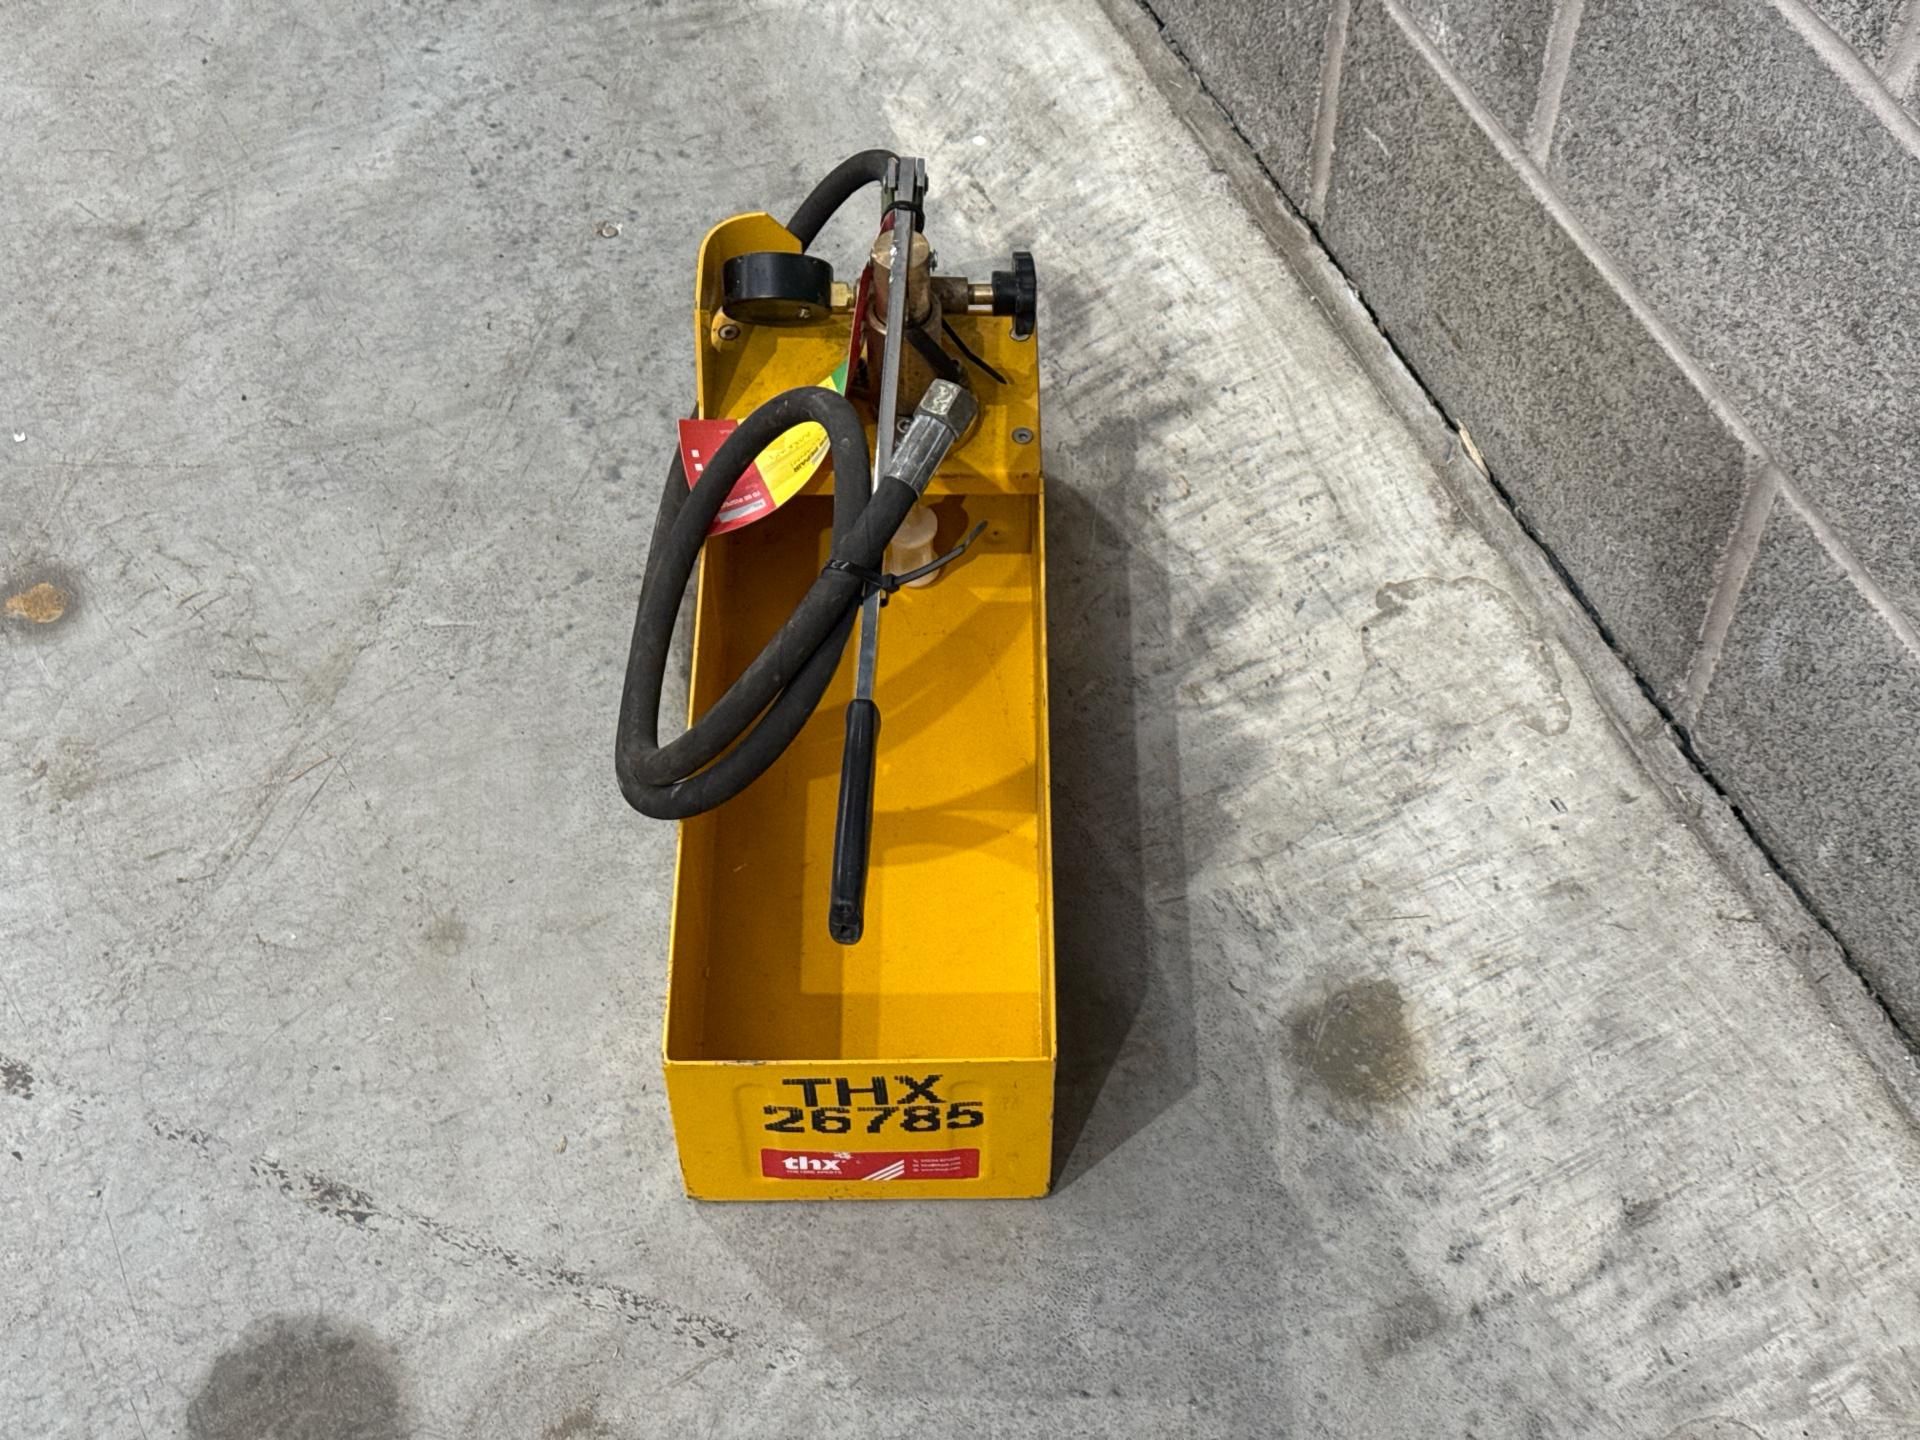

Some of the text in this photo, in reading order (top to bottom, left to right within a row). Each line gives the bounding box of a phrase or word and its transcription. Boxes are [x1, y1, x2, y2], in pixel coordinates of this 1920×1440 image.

[782, 1074, 946, 1107] THX
[763, 1101, 984, 1134] 26785
[782, 1156, 841, 1170] thx
